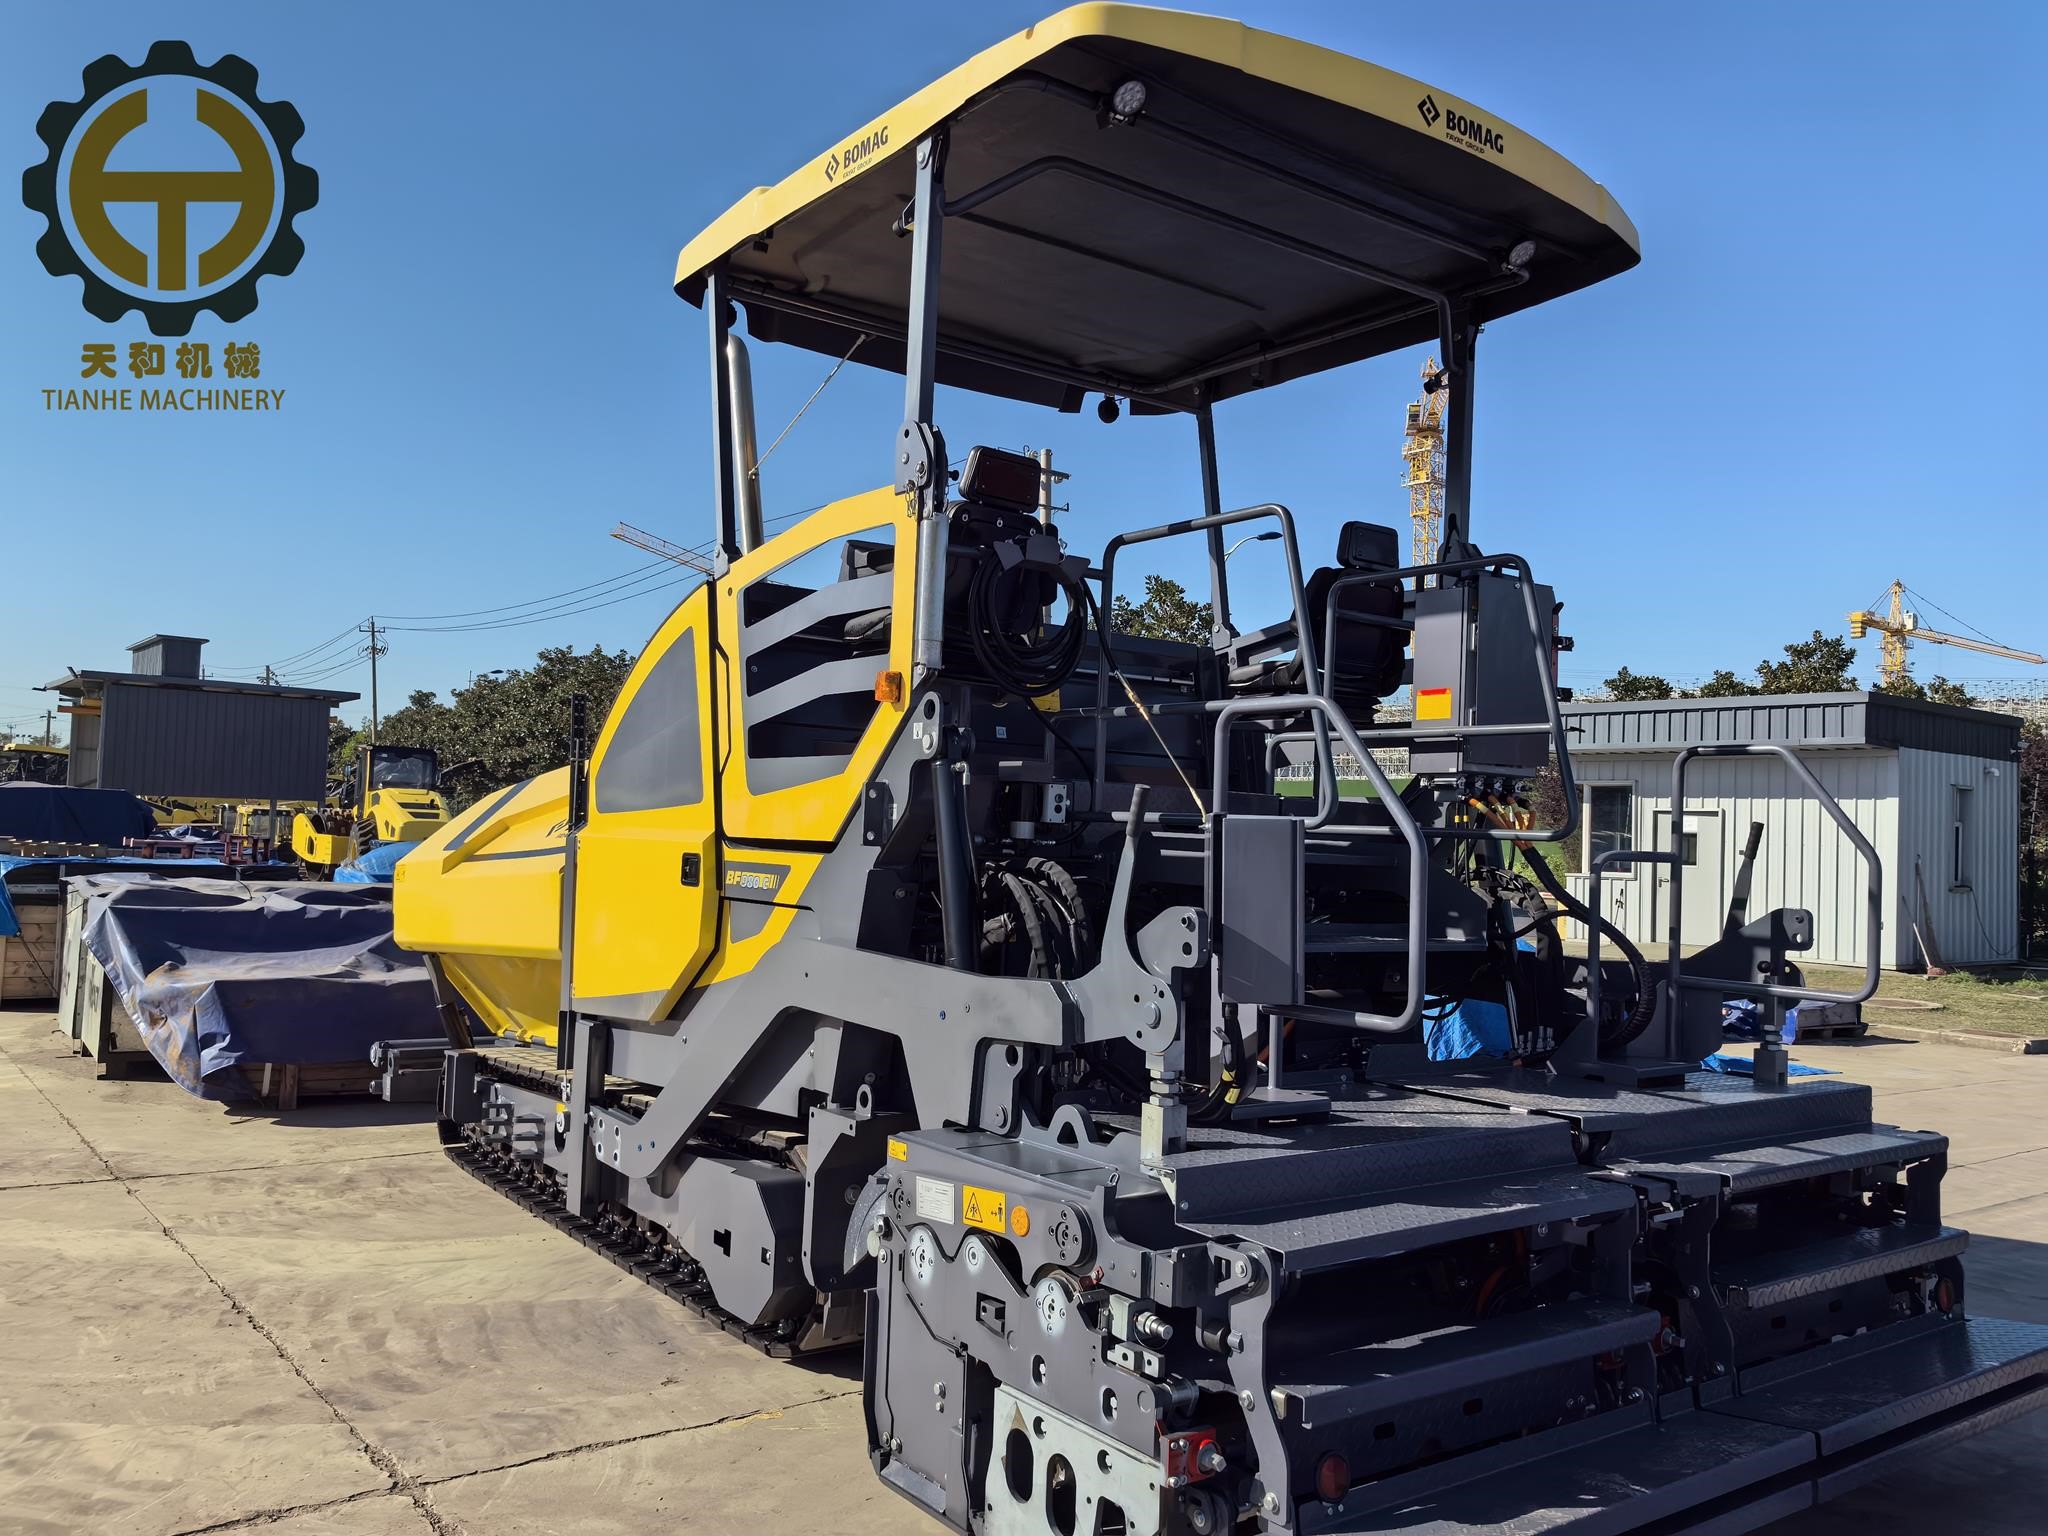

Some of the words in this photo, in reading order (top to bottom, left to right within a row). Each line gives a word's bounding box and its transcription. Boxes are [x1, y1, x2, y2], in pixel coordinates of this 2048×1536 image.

[1446, 109, 1504, 154] BOMAG
[843, 125, 889, 169] BOMAG
[1465, 141, 1485, 154] GROUP
[857, 157, 873, 171] GROUP
